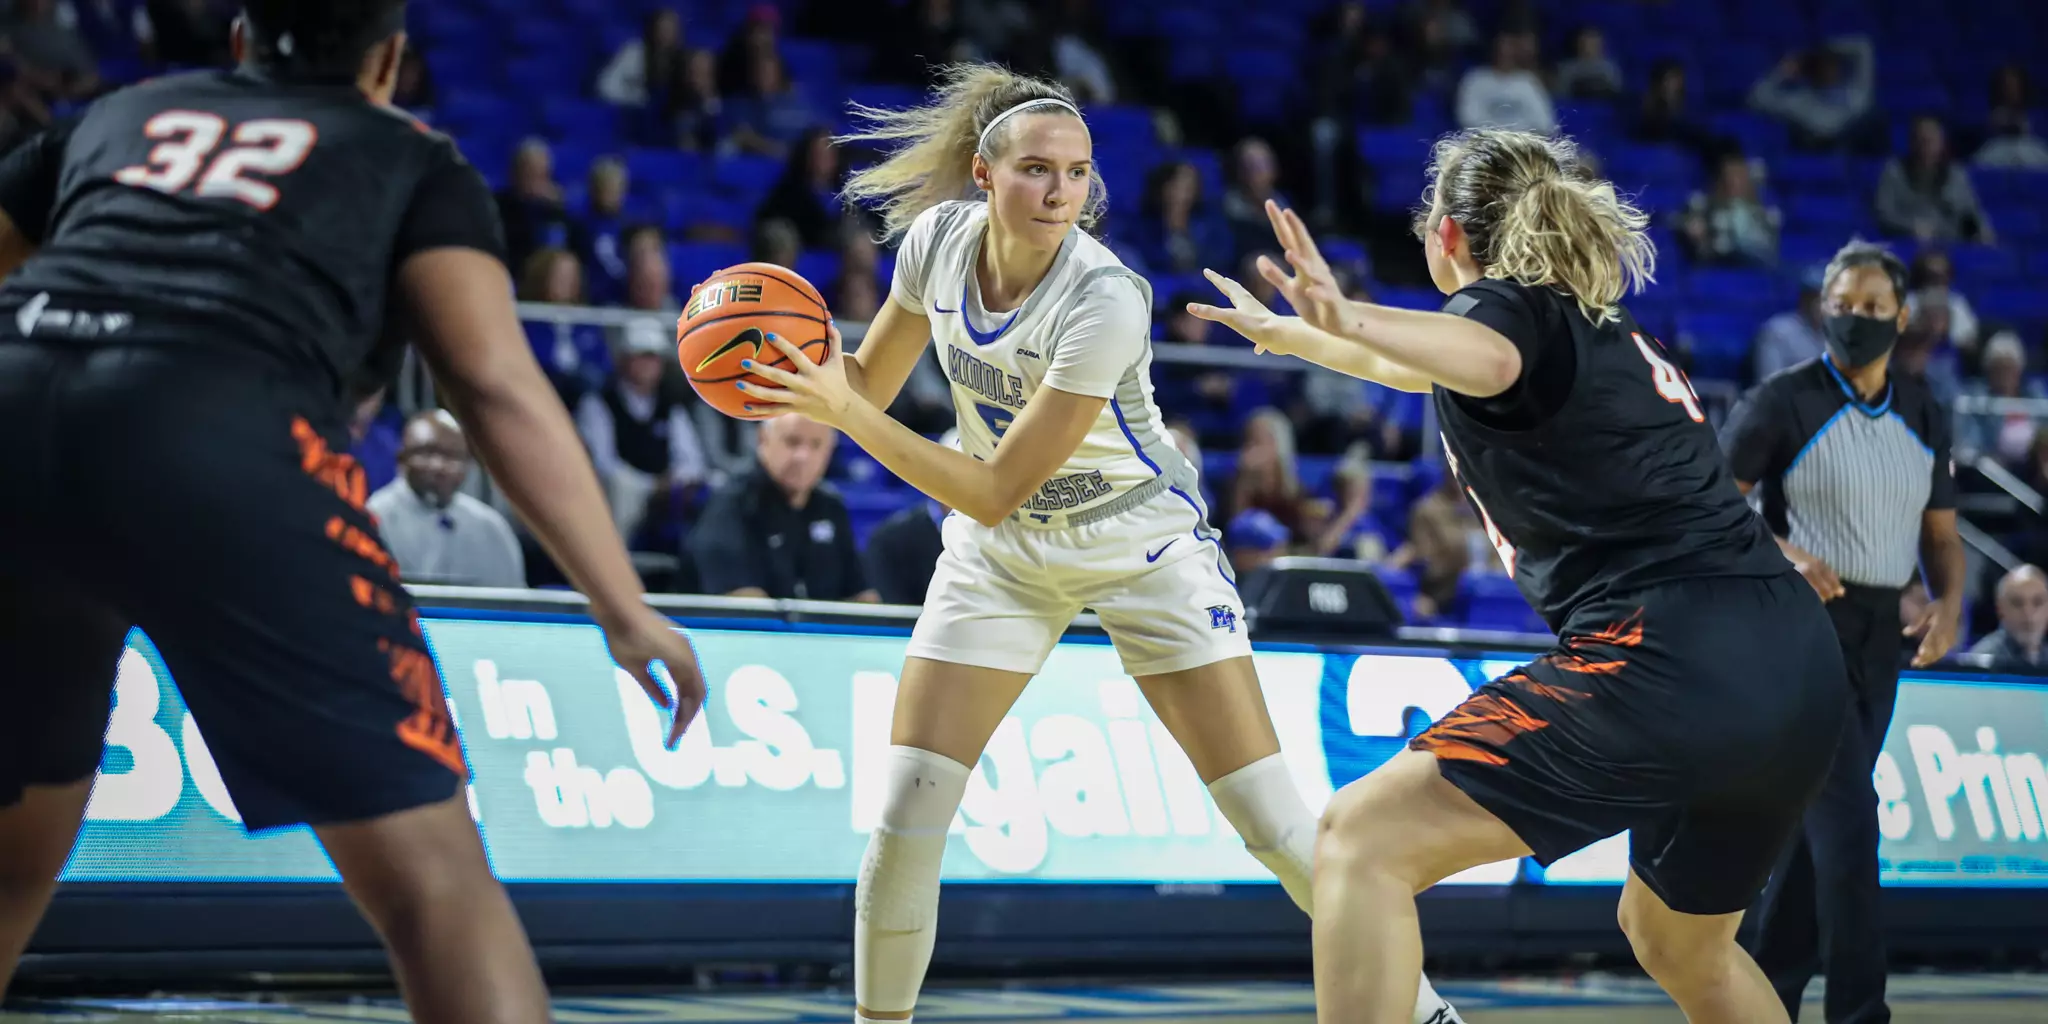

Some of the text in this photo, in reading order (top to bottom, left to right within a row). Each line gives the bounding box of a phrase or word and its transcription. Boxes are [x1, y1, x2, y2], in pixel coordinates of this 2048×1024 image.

[112, 109, 318, 212] 32
[947, 343, 1027, 410] MIDDLE
[473, 658, 559, 741] in
[614, 663, 846, 792] U.S.
[523, 746, 656, 829] the
